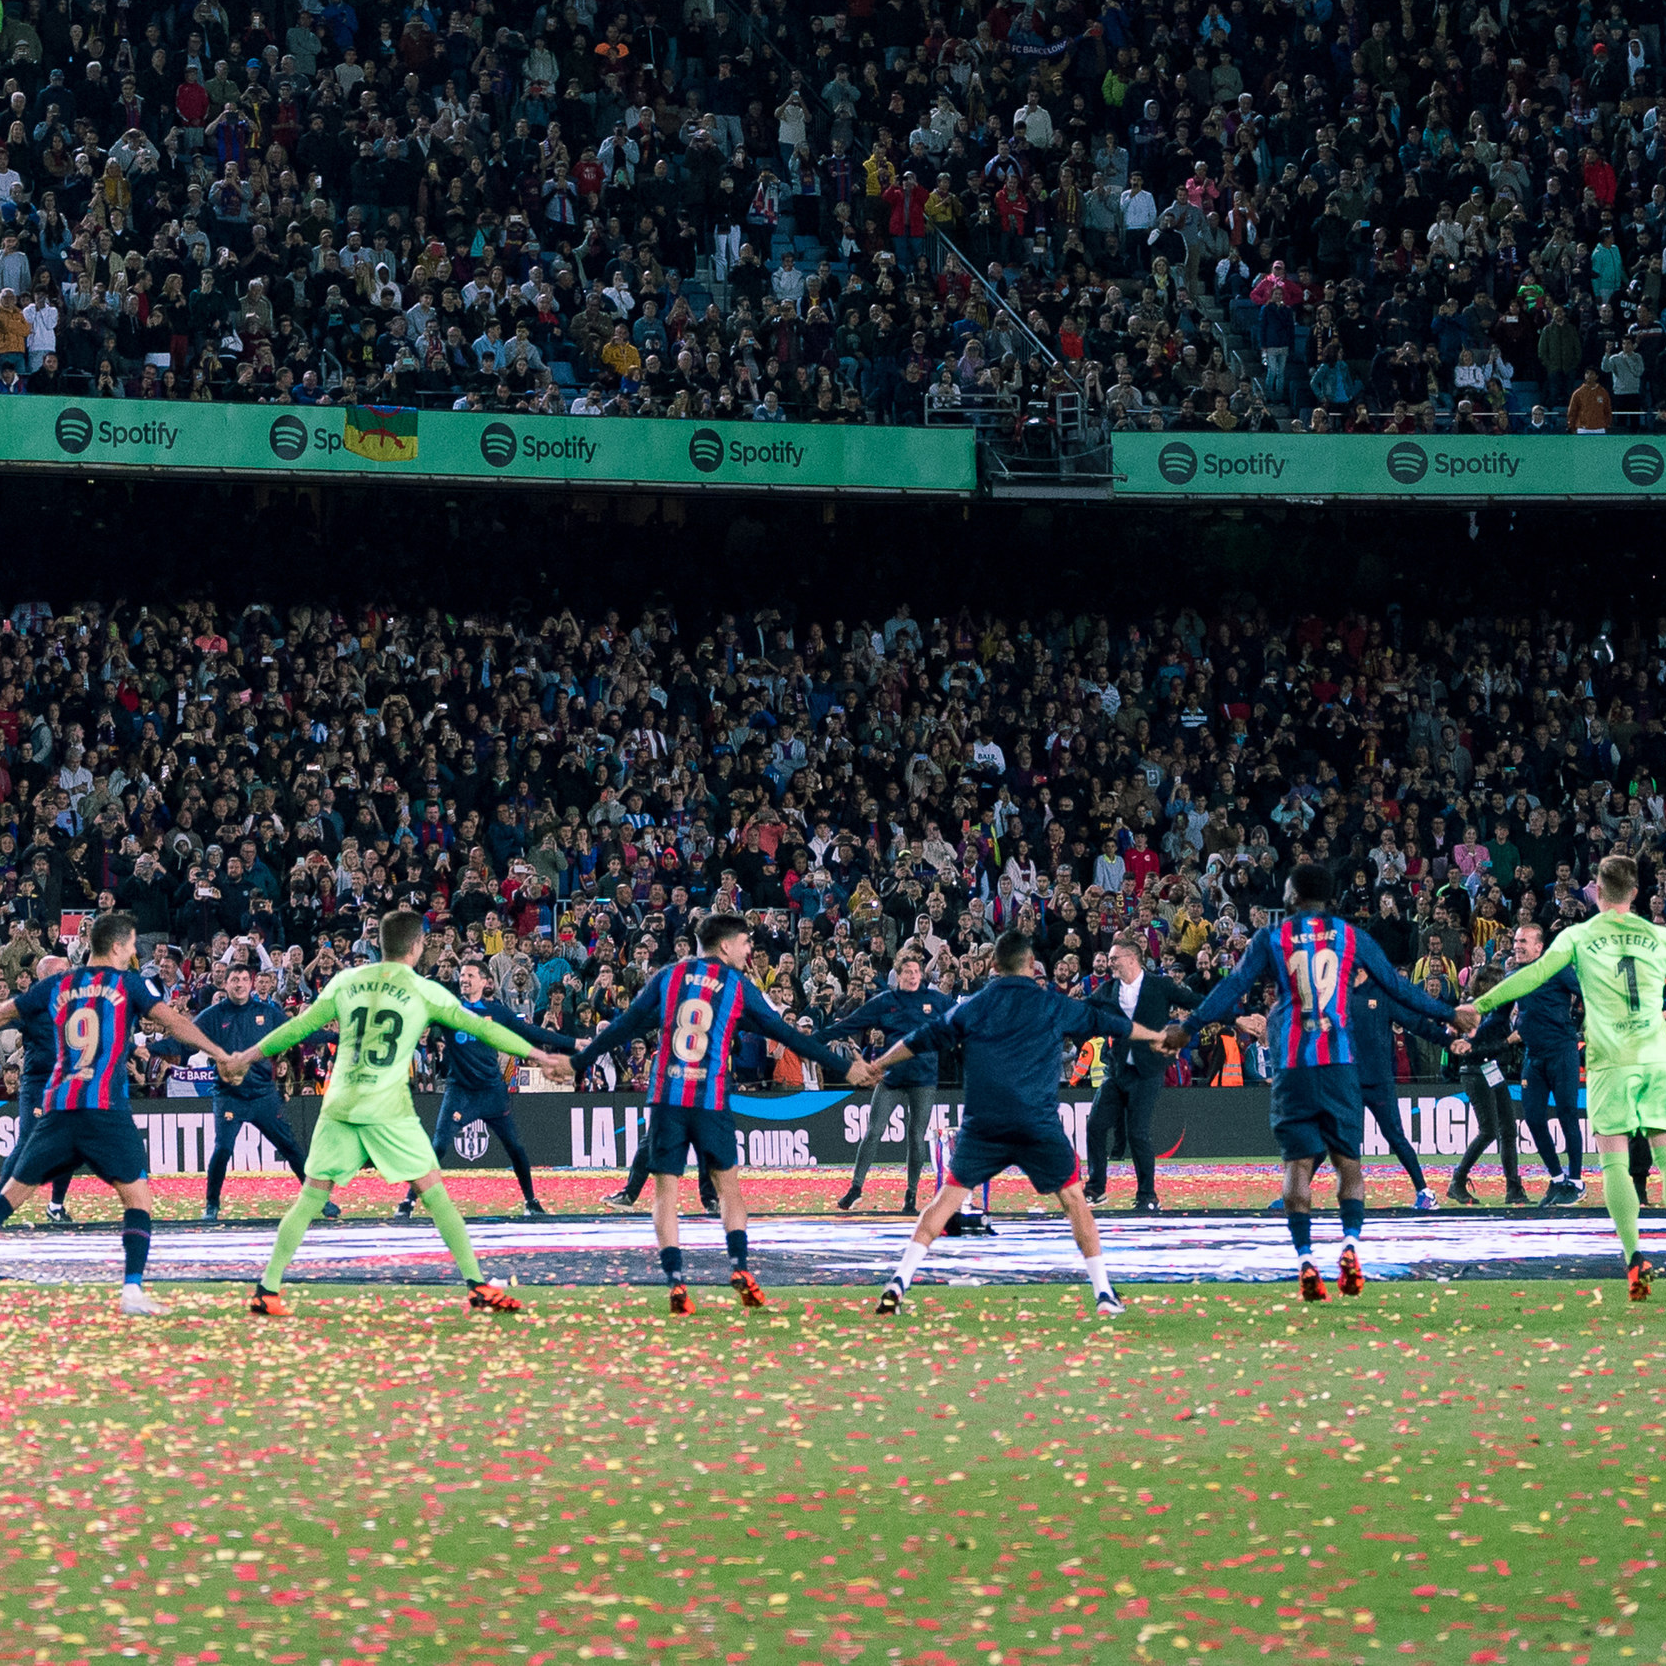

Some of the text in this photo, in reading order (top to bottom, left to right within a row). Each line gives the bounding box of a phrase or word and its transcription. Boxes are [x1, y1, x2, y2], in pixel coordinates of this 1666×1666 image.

[98, 421, 178, 449] Spotify
[523, 435, 597, 463] Spotify
[729, 440, 804, 467] Spotify
[1203, 453, 1285, 479] Spotify
[1434, 452, 1520, 477] Spotify
[1587, 934, 1658, 955] TER STEGEN
[381, 982, 411, 1005] PEÑA
[684, 973, 724, 994] PEDRI
[1289, 947, 1339, 1013] 19
[1616, 955, 1640, 1013] 1
[65, 1007, 100, 1070] 9
[349, 1007, 404, 1068] 13
[672, 998, 713, 1063] 8
[570, 1107, 617, 1168] LA
[748, 1129, 818, 1166] OURS.
